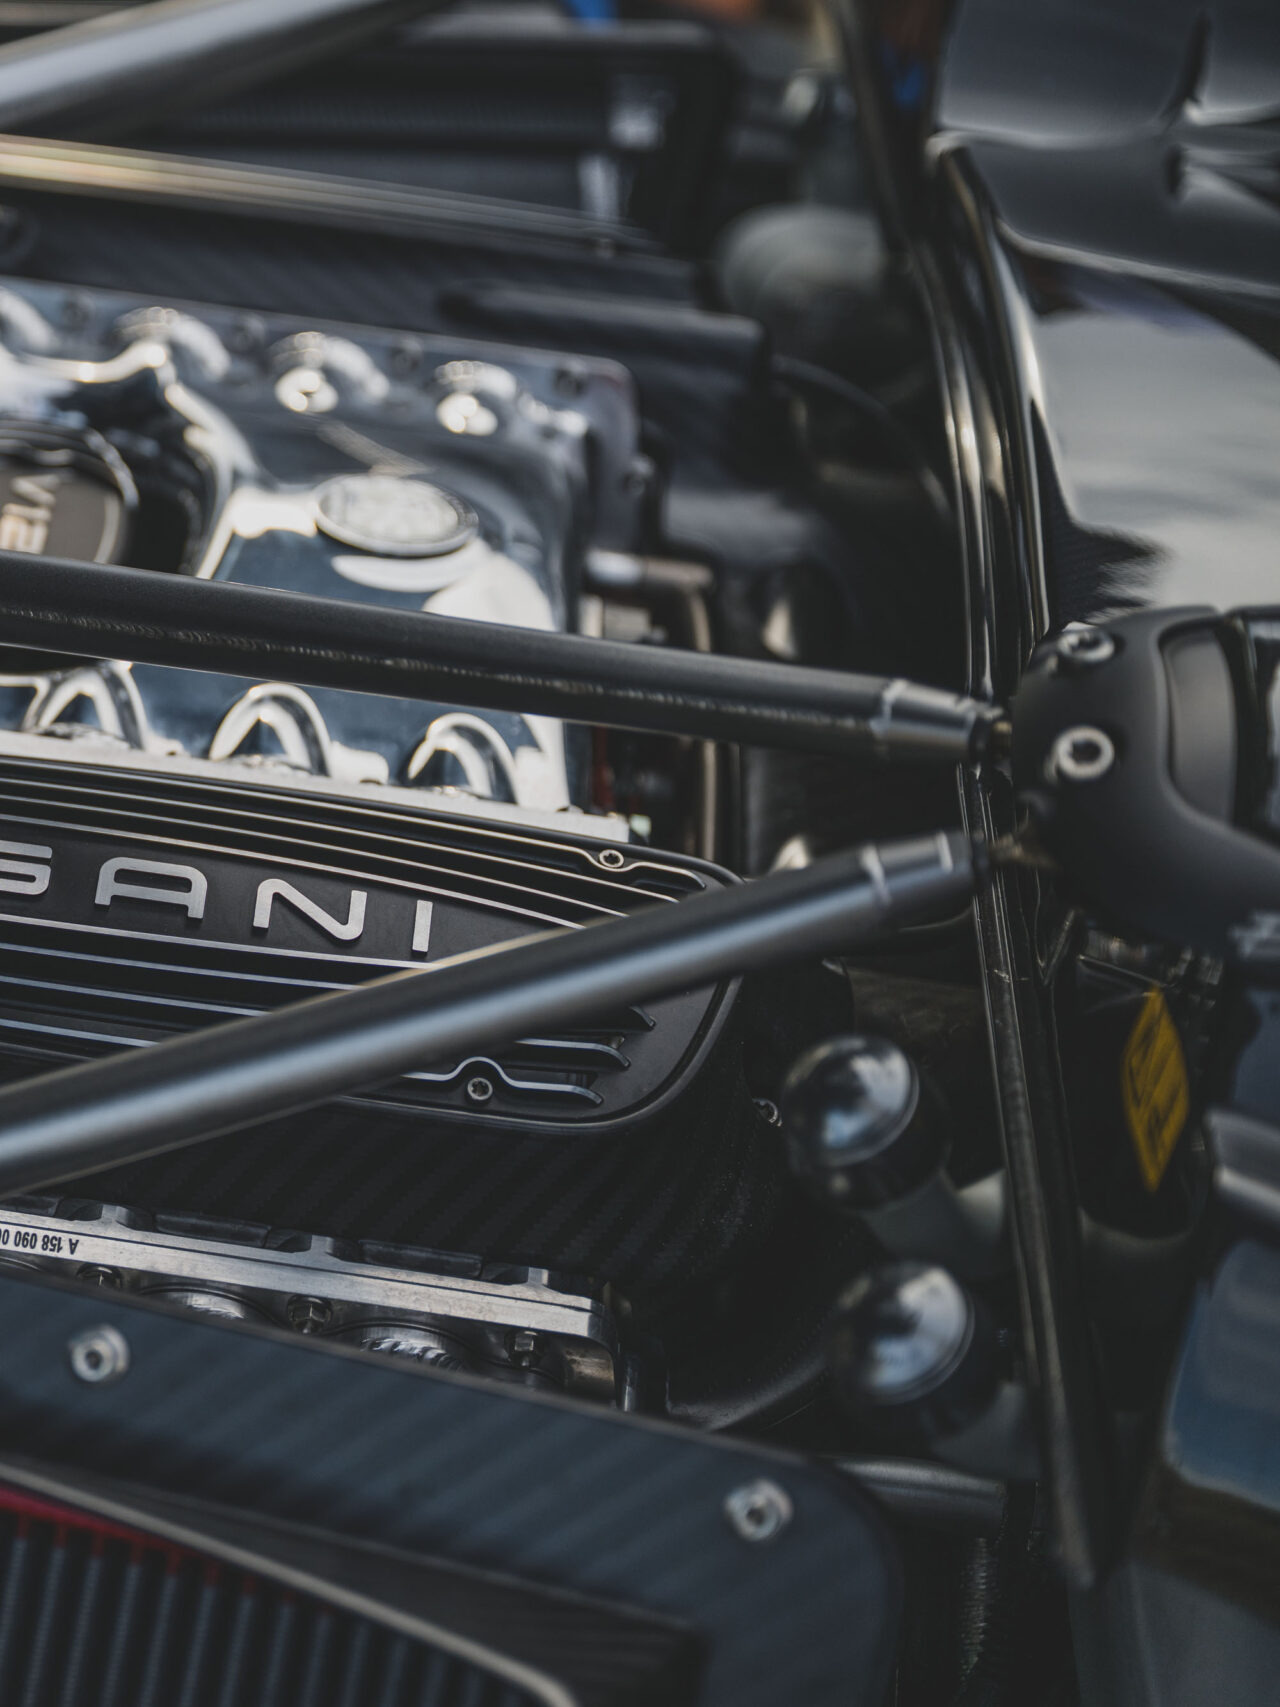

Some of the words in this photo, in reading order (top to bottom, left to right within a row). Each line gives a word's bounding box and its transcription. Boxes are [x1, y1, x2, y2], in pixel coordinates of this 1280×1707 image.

[14, 1228, 38, 1249] 090
[41, 1234, 63, 1253] 158
[68, 1238, 80, 1255] A
